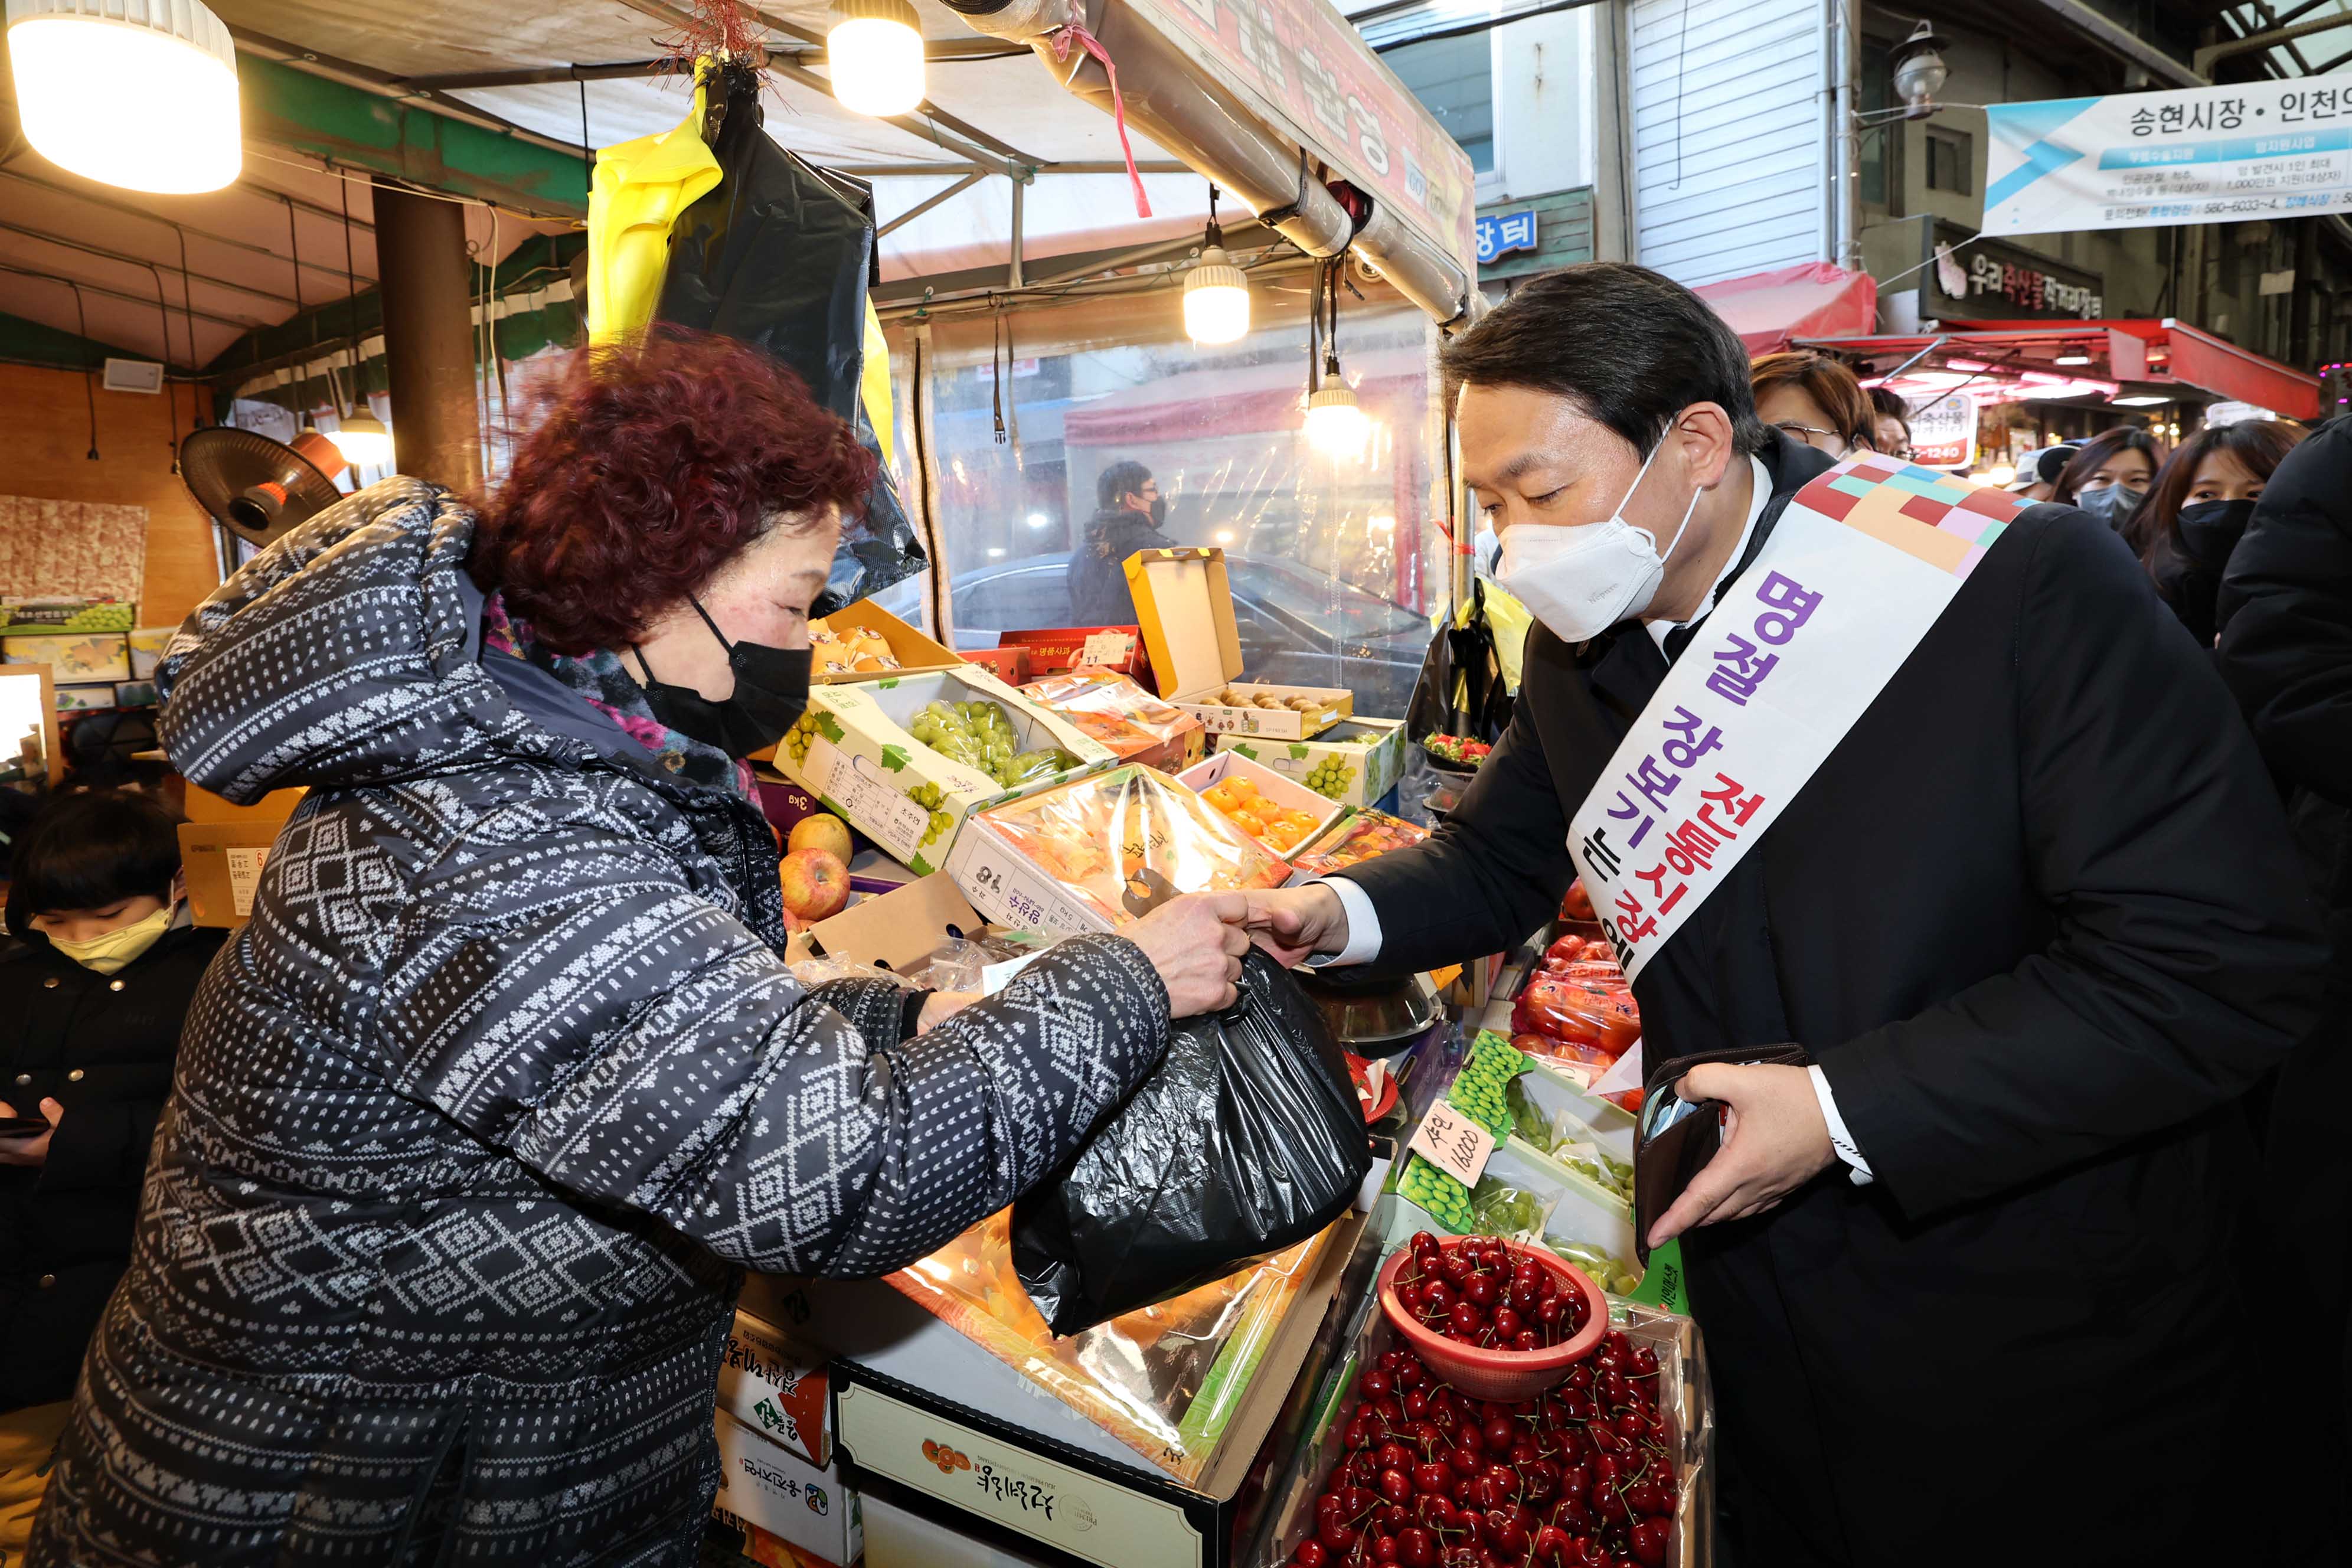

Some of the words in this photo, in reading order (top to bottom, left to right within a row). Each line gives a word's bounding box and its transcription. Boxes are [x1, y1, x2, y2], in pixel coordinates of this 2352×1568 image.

[2131, 98, 2246, 137] 송현시장
[1705, 570, 1823, 707] 명절
[789, 795, 807, 811] 3kg
[1583, 705, 1724, 883] 장보기는
[976, 866, 1002, 894] 18
[1602, 772, 1765, 971] 전통시장에
[1009, 895, 1041, 925] 양상수
[1060, 906, 1073, 920] 5kg
[1450, 1130, 1479, 1172] 16000
[744, 1459, 802, 1498] 웅진자연
[976, 1465, 1054, 1521] 천혜향
